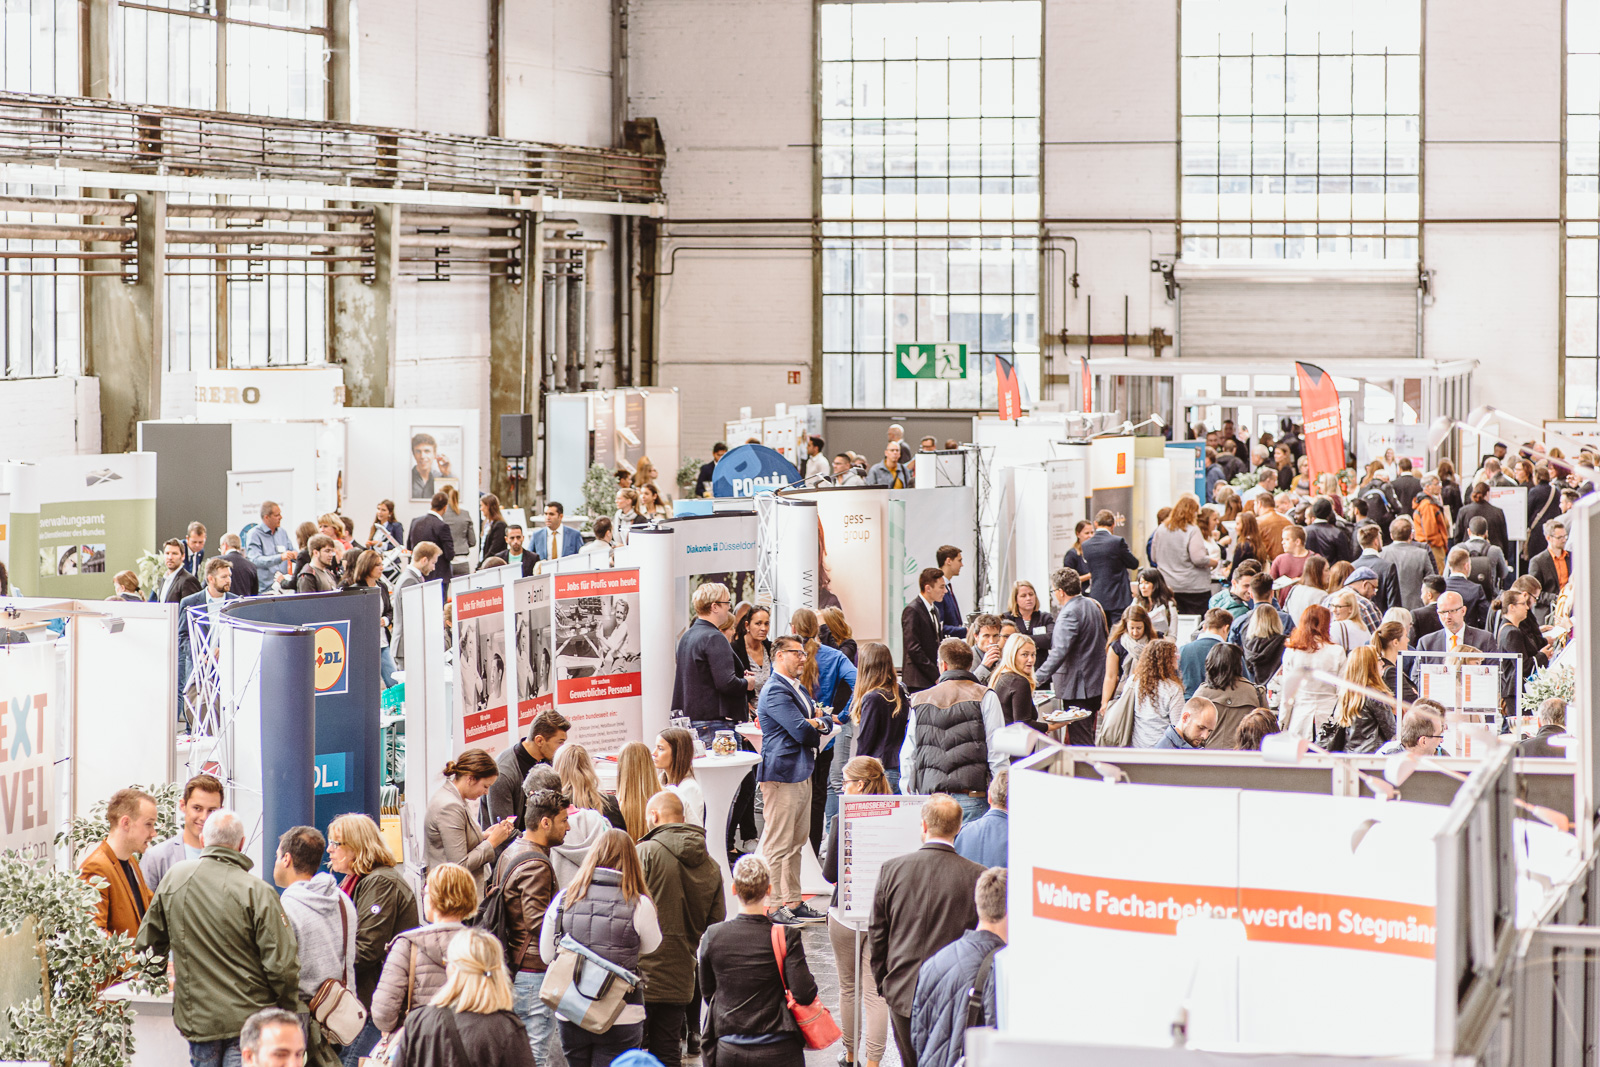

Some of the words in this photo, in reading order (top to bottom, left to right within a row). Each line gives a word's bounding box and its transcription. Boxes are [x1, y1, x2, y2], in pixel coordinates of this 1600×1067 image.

[195, 385, 261, 404] RERO
[843, 529, 870, 543] group
[686, 544, 712, 554] Diakonie
[719, 541, 756, 552] Düsseldorf
[566, 582, 580, 592] Jobs
[580, 580, 590, 590] für
[590, 579, 607, 590] Profis
[607, 580, 619, 588] von
[619, 577, 637, 587] heute
[569, 687, 607, 700] Gewerbliches
[607, 684, 633, 695] Personal
[1036, 880, 1092, 912] Wahre
[1242, 905, 1332, 932] werden
